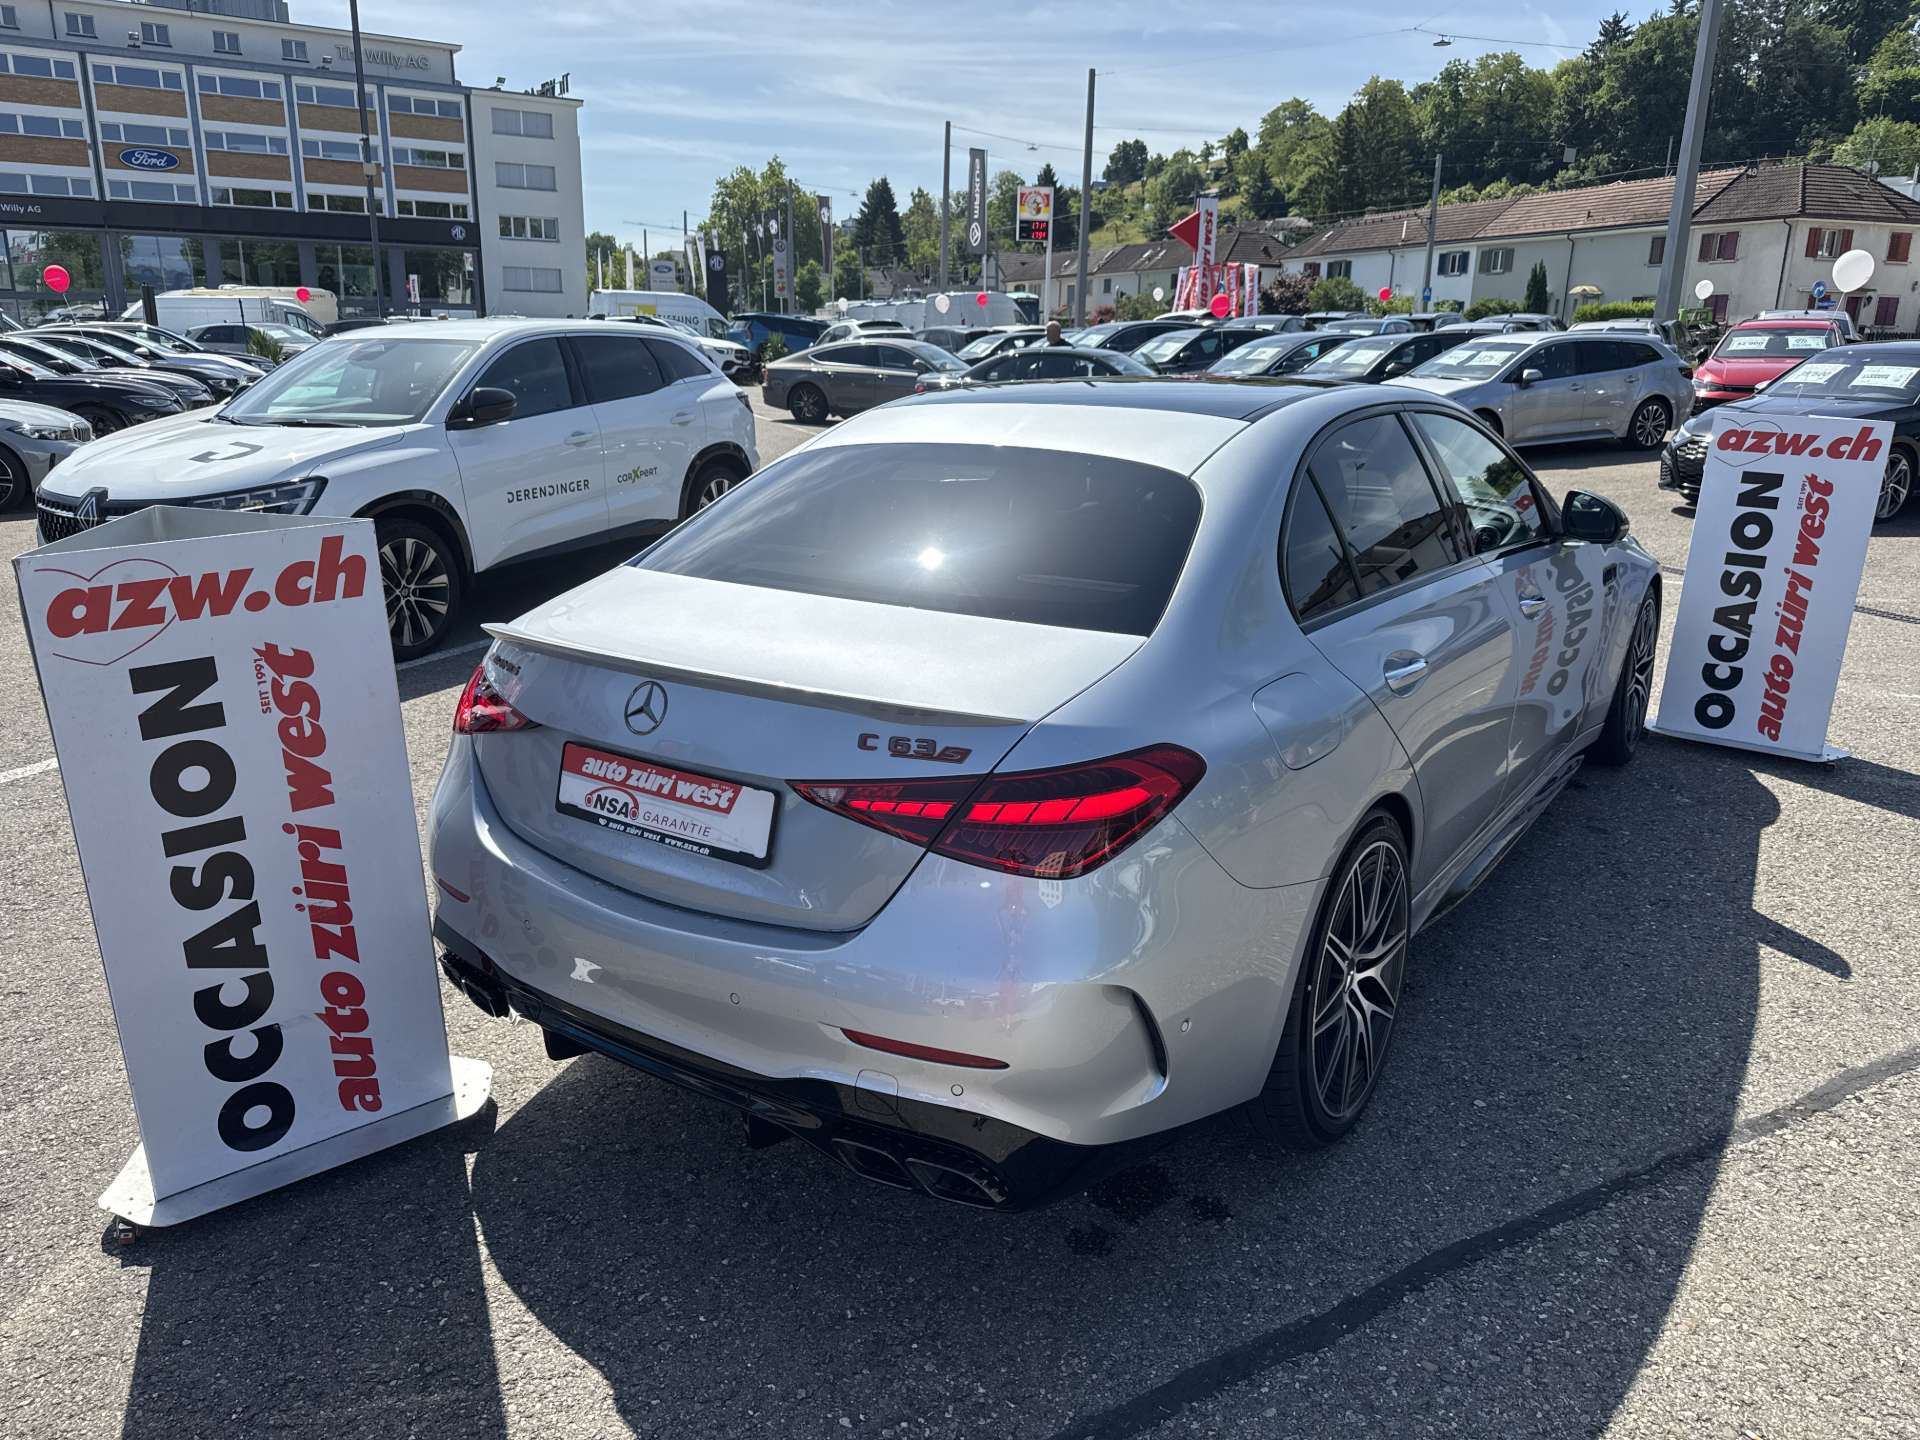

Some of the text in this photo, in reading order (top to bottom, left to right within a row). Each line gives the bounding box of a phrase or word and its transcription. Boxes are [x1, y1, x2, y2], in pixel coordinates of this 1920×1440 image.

[365, 47, 402, 72] Willy
[406, 55, 431, 72] AG
[131, 150, 168, 167] Ford
[0, 203, 41, 214] Willy AG
[1717, 427, 1882, 461] azw.ch
[507, 479, 590, 503] DERENDINGER
[47, 535, 366, 638] azw.ch
[1694, 471, 1784, 729] OCCASION
[1758, 473, 1834, 741] auto züri west
[253, 658, 271, 714] SEIT 1991
[857, 733, 879, 751] C
[581, 756, 735, 809] auto züri west
[594, 793, 630, 818] NSA
[608, 821, 624, 832] auto
[643, 829, 661, 843] west
[664, 836, 710, 857] www.azw.ch
[642, 811, 712, 837] GARANTIE
[252, 642, 382, 1112] auto züri west
[129, 656, 295, 1152] OCCASION
